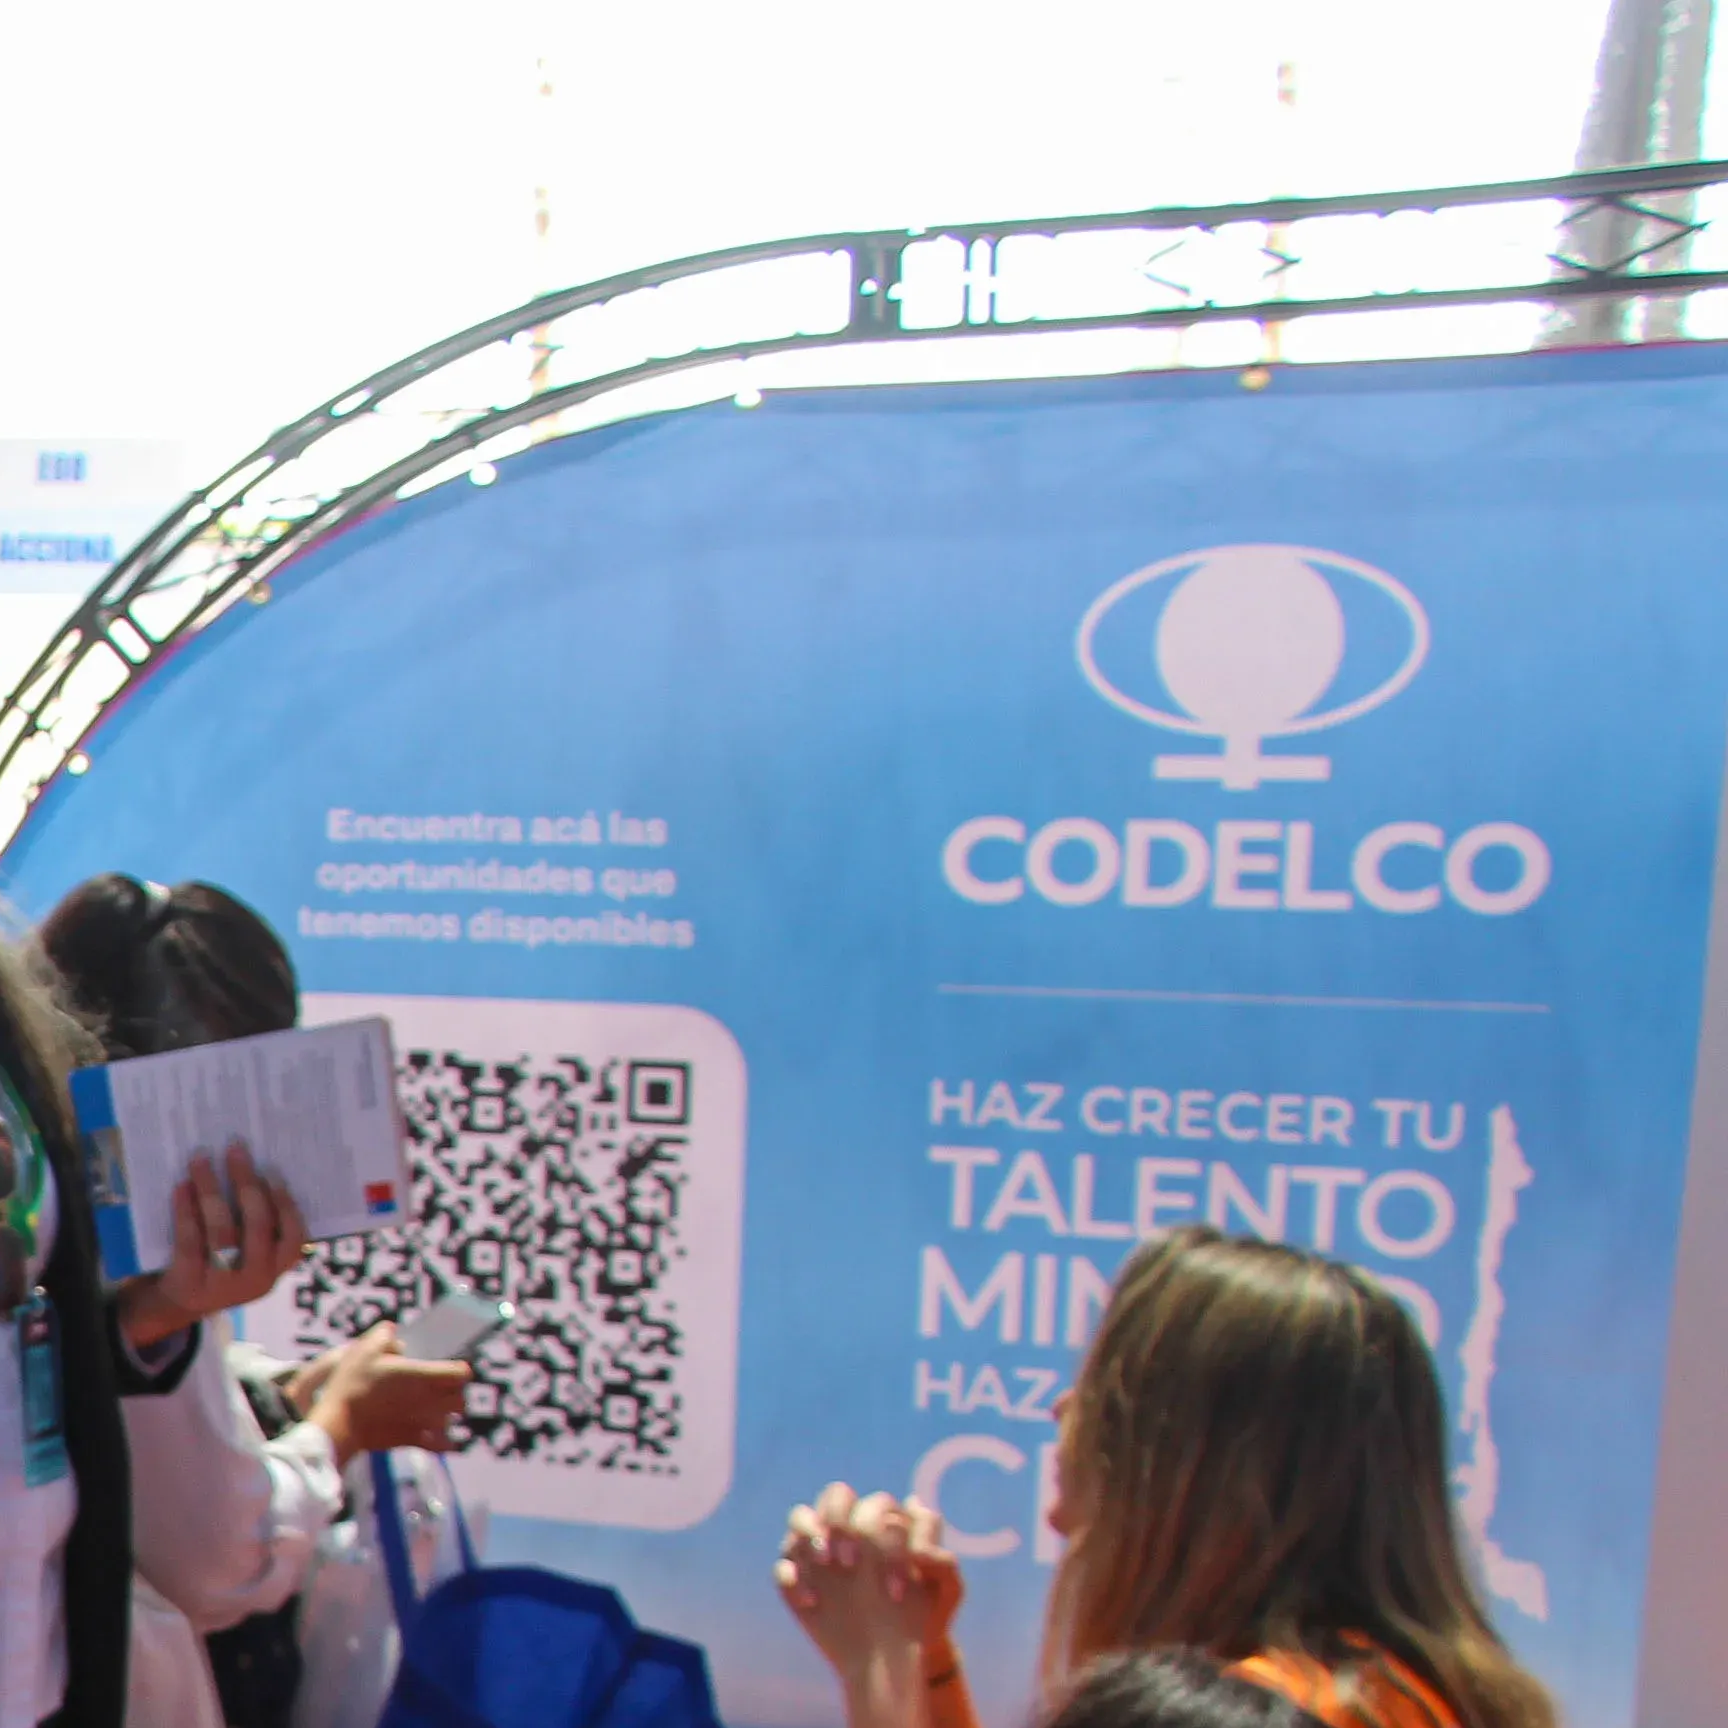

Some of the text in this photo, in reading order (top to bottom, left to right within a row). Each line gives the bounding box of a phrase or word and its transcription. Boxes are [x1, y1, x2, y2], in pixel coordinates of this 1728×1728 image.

[327, 808, 667, 846] Encuentra acá las
[316, 858, 676, 900] oportunidades que
[942, 814, 1552, 916] CODELCO
[297, 904, 696, 949] tenemos disponibles
[927, 1077, 1465, 1152] HAZ CRECER TU
[928, 1145, 1456, 1261] TALENTO
[914, 1360, 1060, 1422] HAZ
